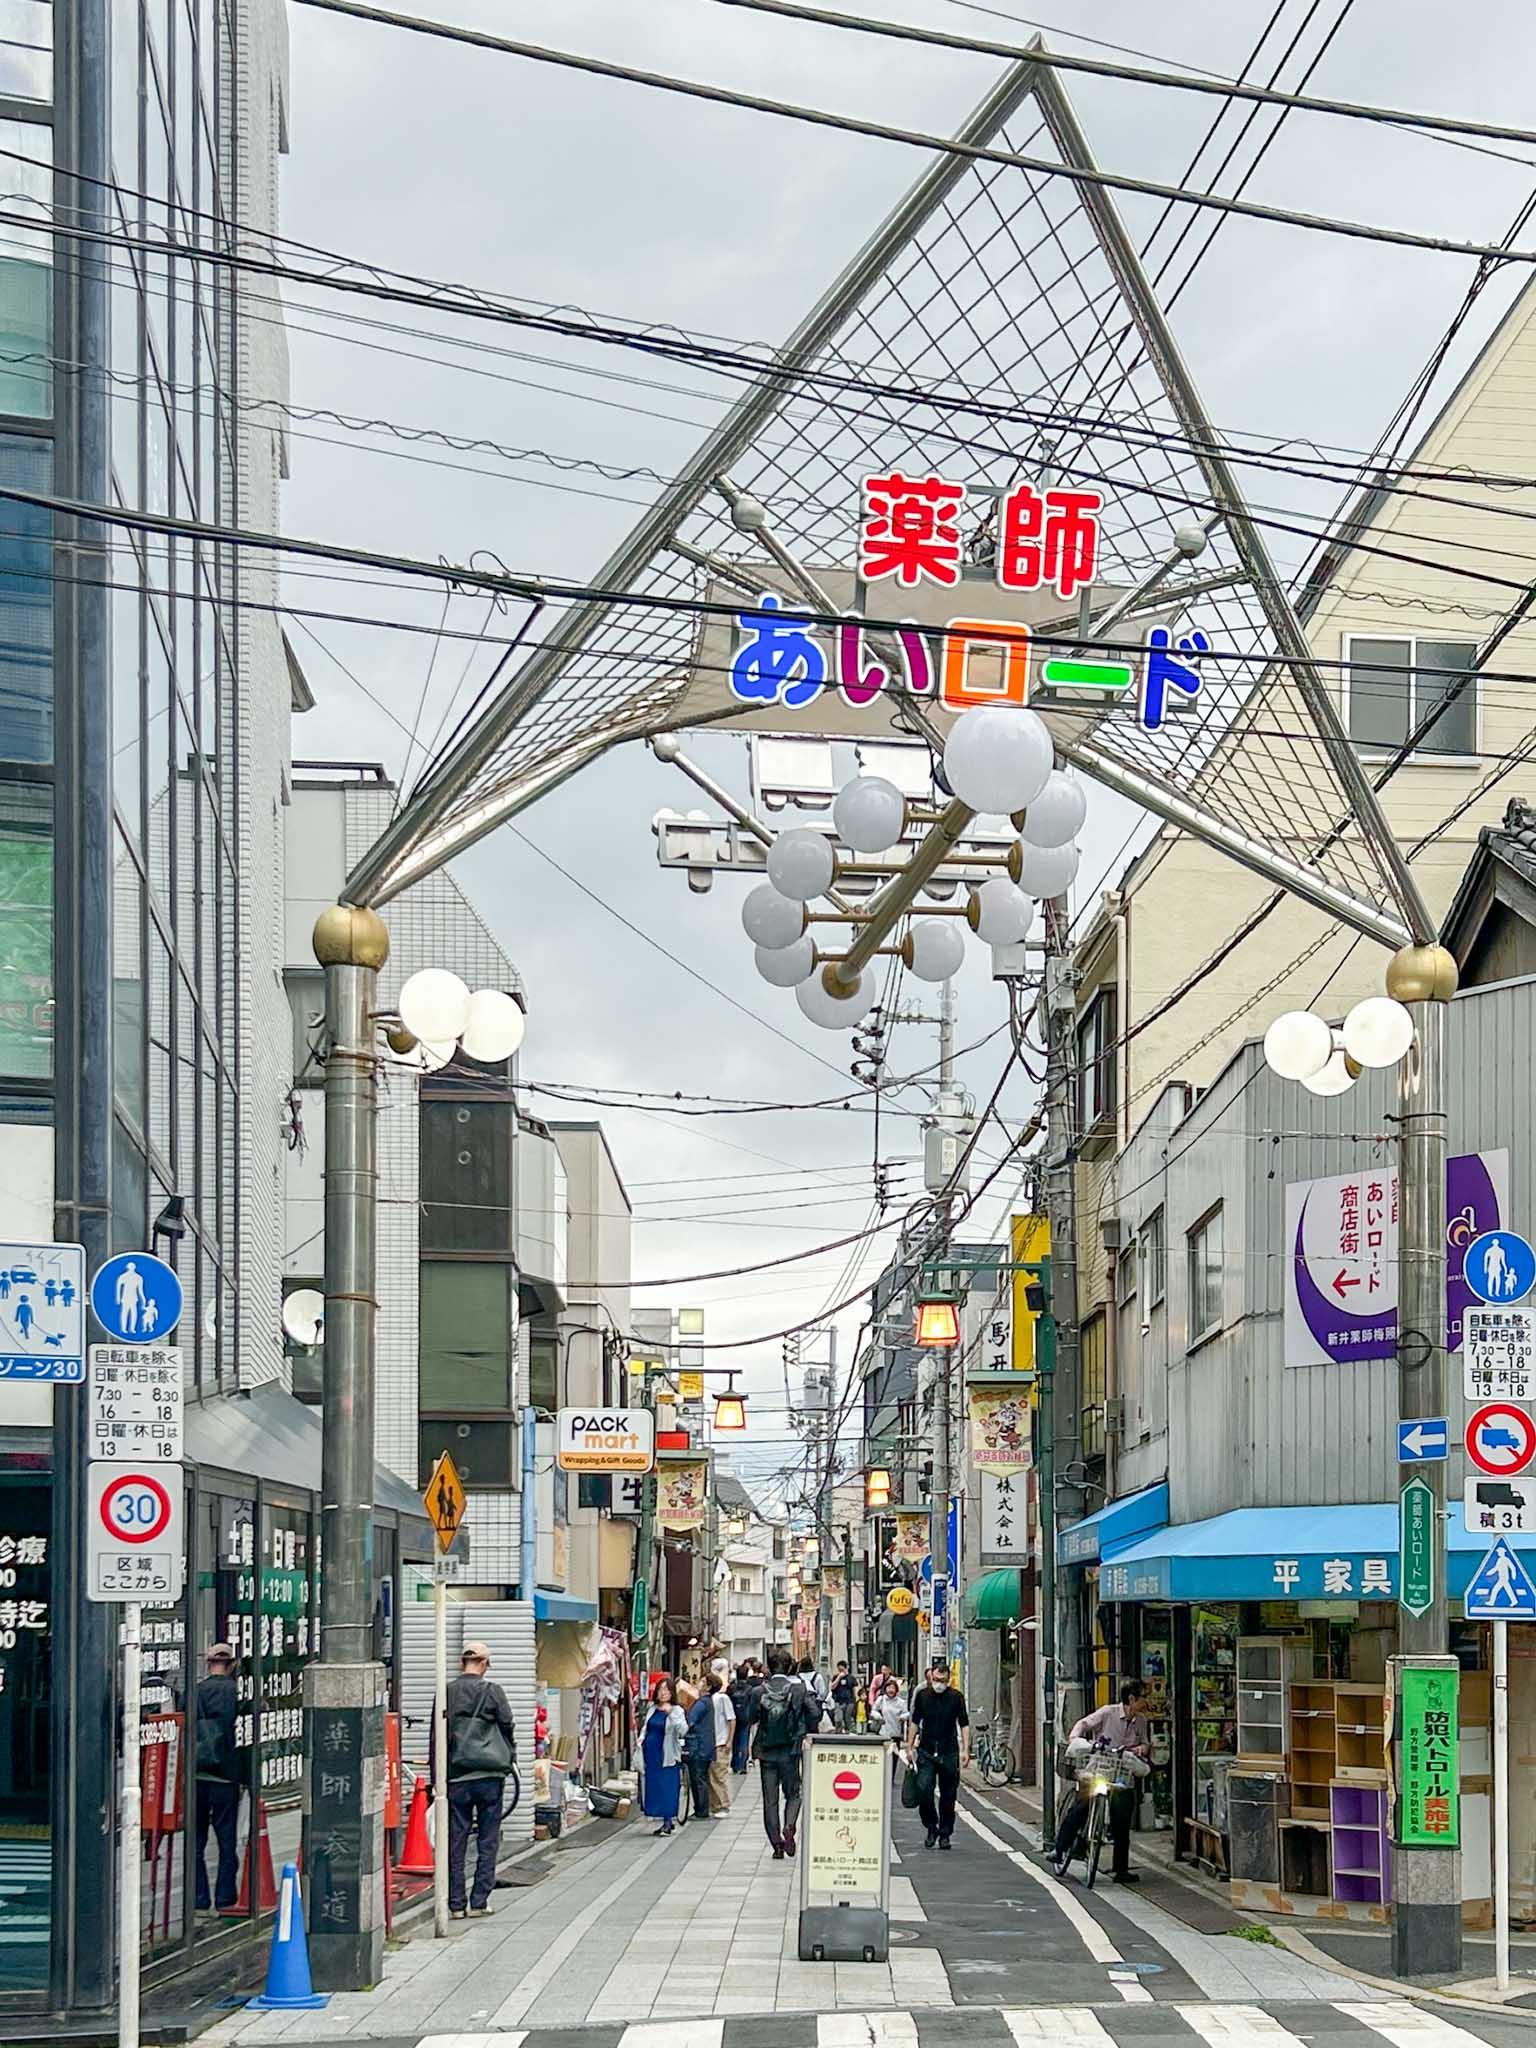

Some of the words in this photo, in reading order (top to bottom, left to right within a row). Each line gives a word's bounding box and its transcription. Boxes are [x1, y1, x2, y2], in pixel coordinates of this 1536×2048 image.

[860, 470, 1103, 600] 薬師
[730, 593, 1214, 731] あいロード
[1340, 1184, 1360, 1255] 商店街
[1367, 1182, 1383, 1293] あいロード
[95, 1350, 178, 1365] 自転車を除く
[100, 1404, 116, 1419] 16
[157, 1405, 173, 1420] 18
[100, 1441, 116, 1456] 13
[157, 1443, 173, 1457] 18
[584, 1433, 639, 1449] mart
[116, 1494, 155, 1524] 30
[996, 1476, 1015, 1549] 株式会社
[118, 1557, 152, 1571] 区域
[1272, 1560, 1300, 1595] 平
[1323, 1559, 1391, 1595] 家具
[103, 1575, 167, 1590] ここから
[889, 1594, 912, 1605] fufu
[1423, 1711, 1450, 1834] 防犯パトロール実施中
[320, 1722, 352, 1924] 薬師参道
